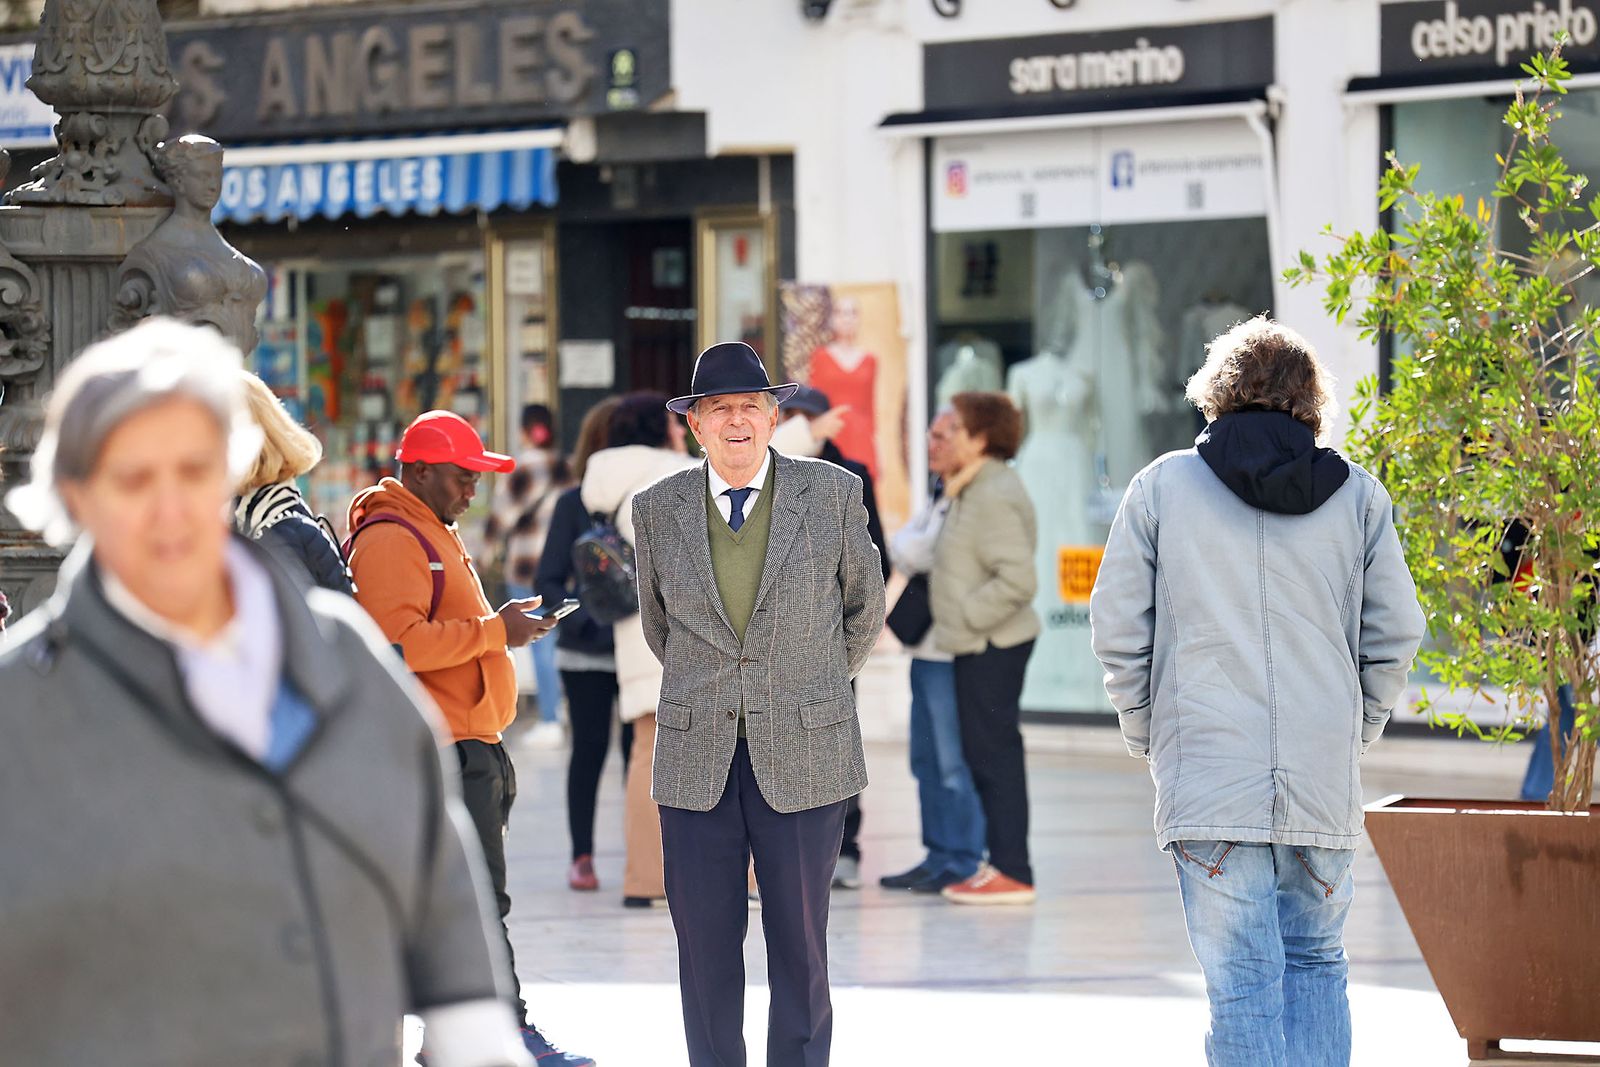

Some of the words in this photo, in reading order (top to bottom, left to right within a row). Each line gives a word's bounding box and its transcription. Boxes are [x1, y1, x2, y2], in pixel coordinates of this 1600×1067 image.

[1008, 54, 1077, 95] sara
[1077, 36, 1185, 89] merino
[1411, 0, 1494, 60] celso
[1495, 0, 1597, 68] prieto
[255, 11, 595, 124] ANGELES
[222, 167, 267, 209] OS
[276, 155, 443, 207] ANGELES
